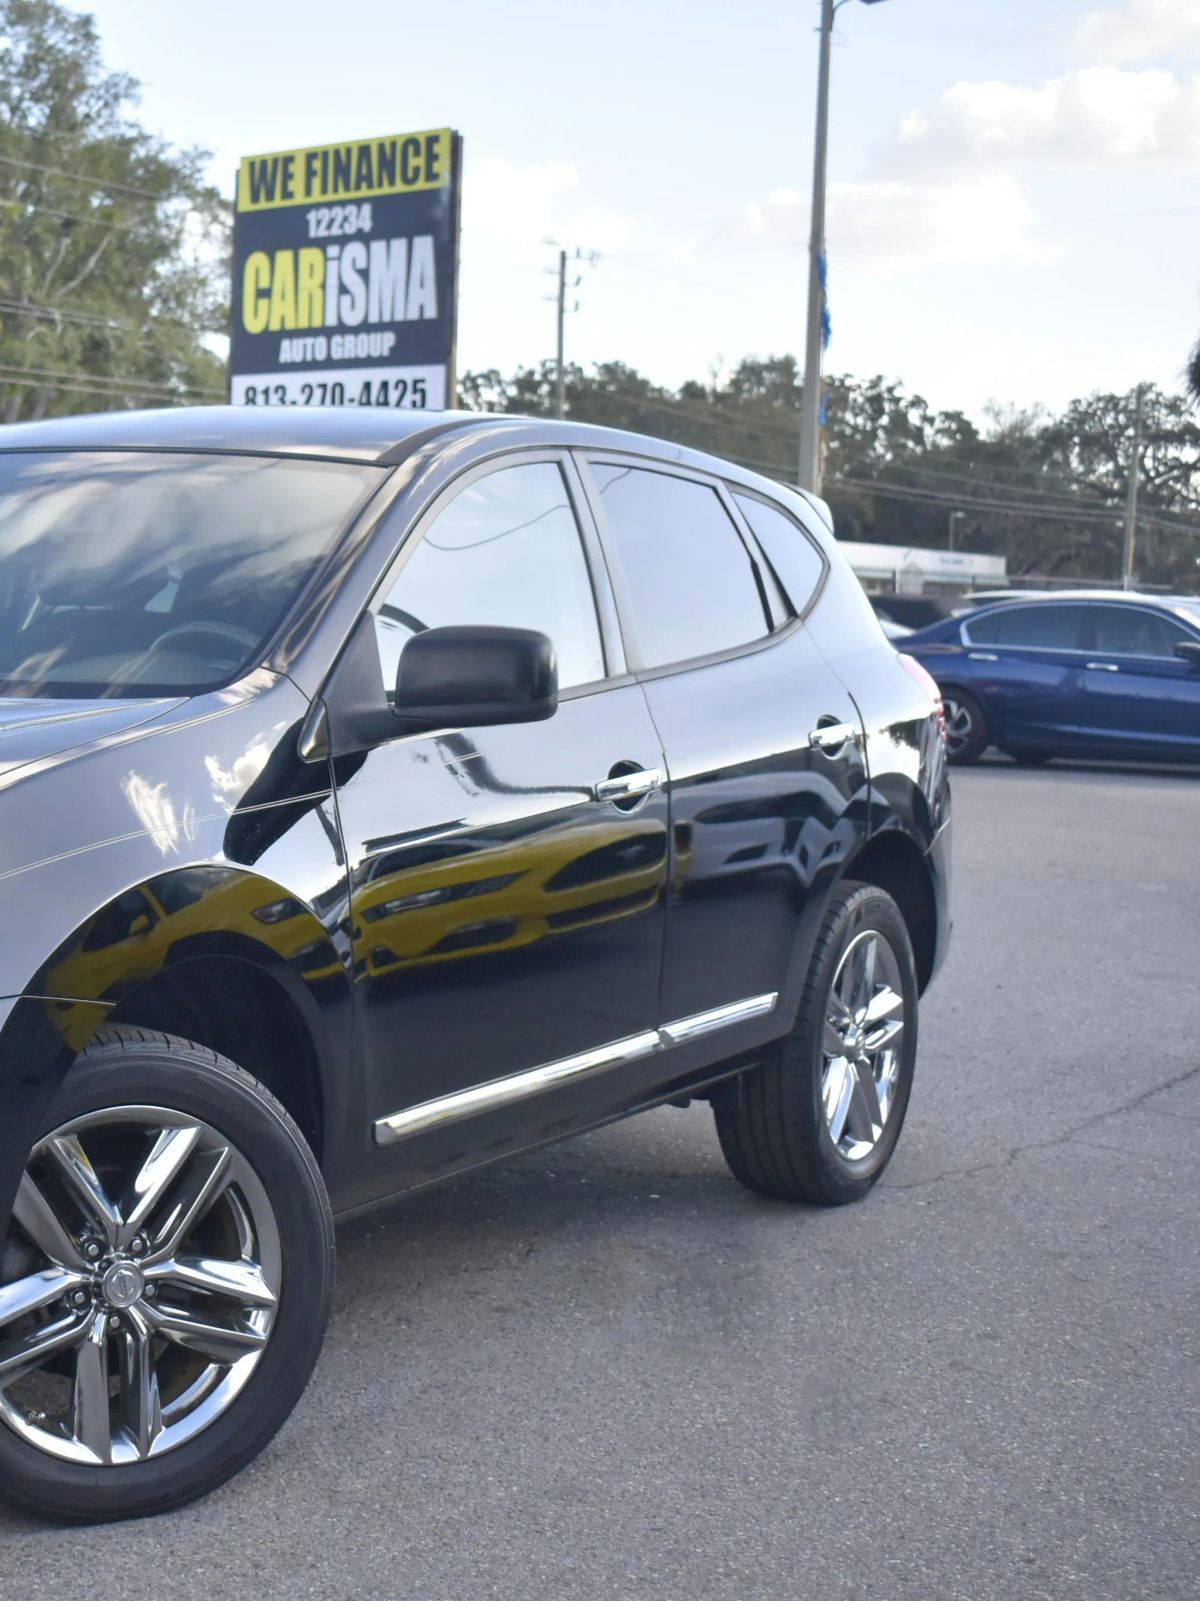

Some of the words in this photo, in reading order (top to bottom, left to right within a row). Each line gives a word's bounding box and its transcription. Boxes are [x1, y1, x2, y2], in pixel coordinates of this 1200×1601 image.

[249, 154, 296, 205] WE
[304, 133, 441, 198] FINANCE
[306, 203, 373, 239] 12234
[242, 234, 439, 335] CARiSMA
[278, 335, 328, 364] AUTO
[329, 331, 397, 361] GROUP
[244, 378, 428, 409] 813-270-4425
